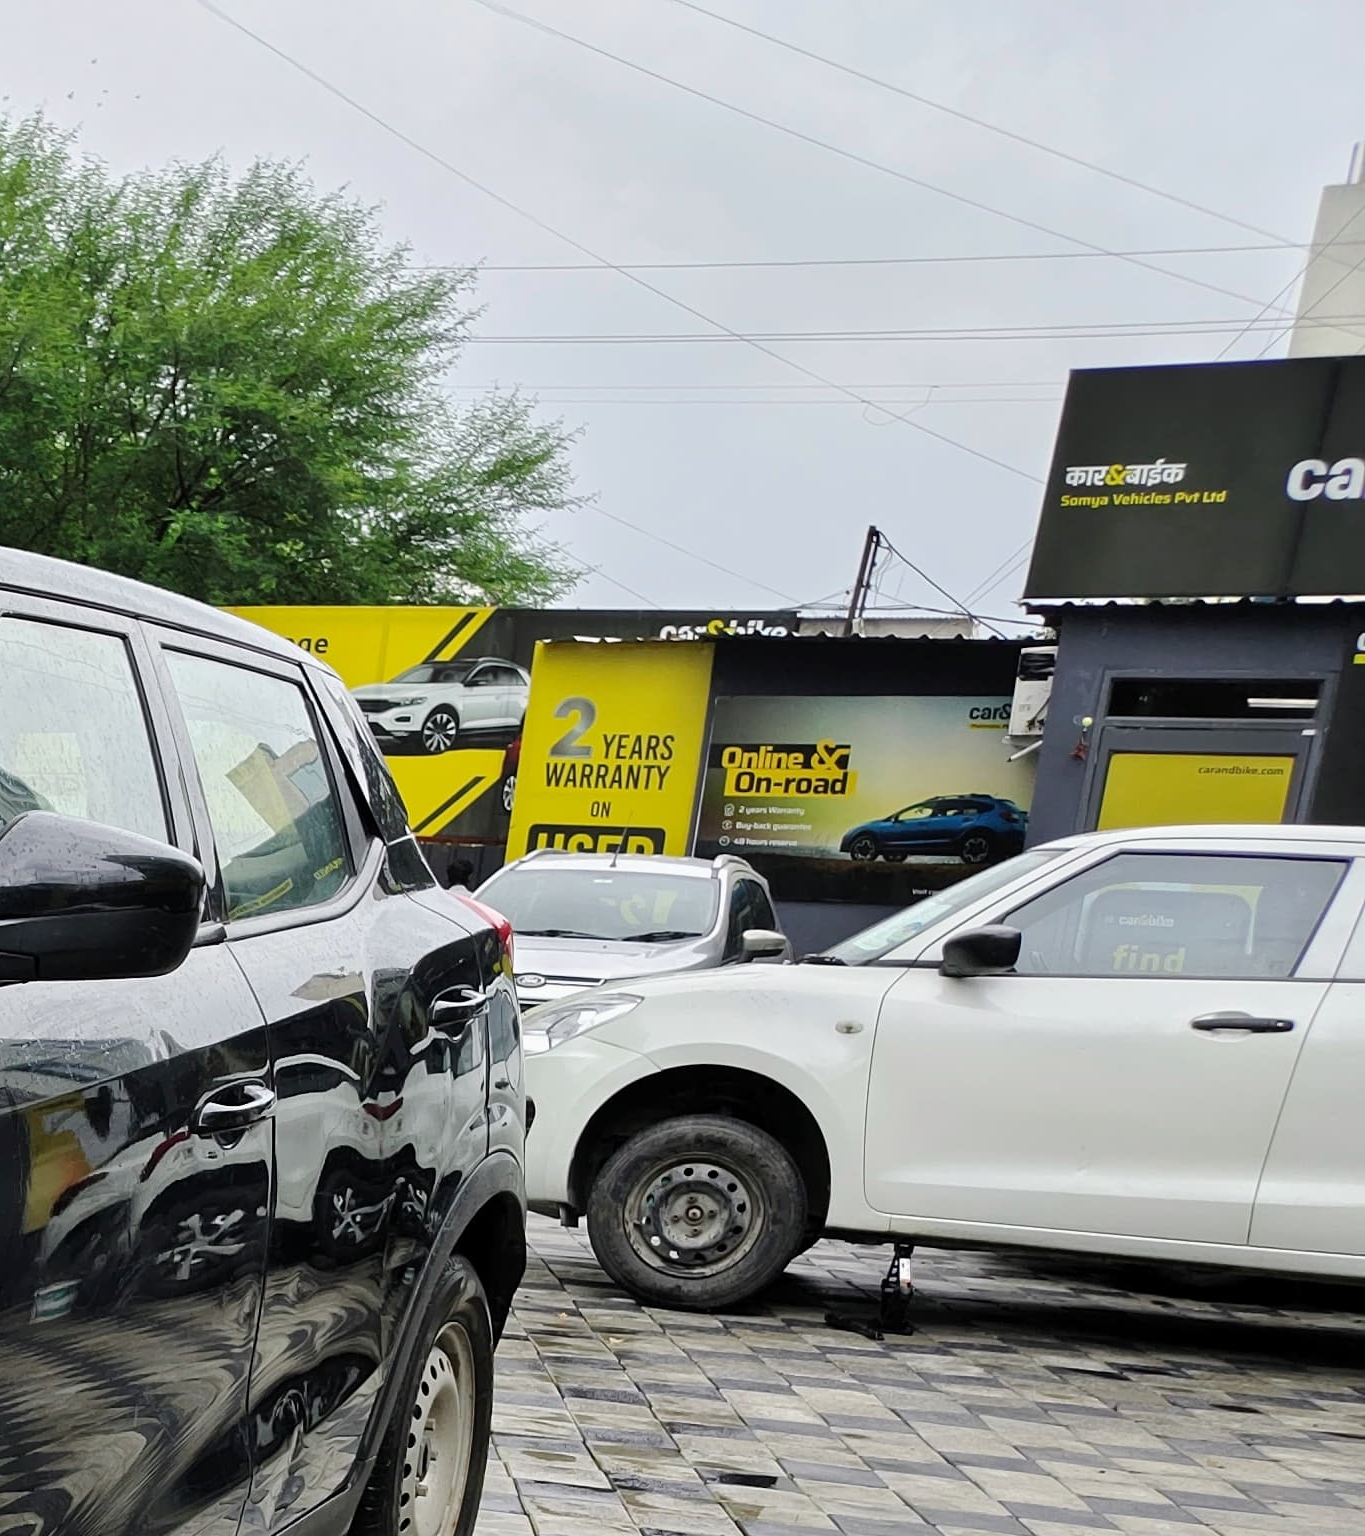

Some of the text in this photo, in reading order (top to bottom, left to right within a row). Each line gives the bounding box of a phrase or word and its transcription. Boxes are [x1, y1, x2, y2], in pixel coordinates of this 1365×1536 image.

[1112, 493, 1171, 506] Vehicles
[1174, 491, 1200, 504] Pvt
[1202, 490, 1228, 504] Ltd
[548, 696, 675, 761] 2 YEARS
[721, 738, 851, 771] Online &
[545, 762, 671, 791] WARRANTY
[734, 770, 849, 795] On-road
[1197, 765, 1285, 776] carandbike.com
[590, 801, 611, 818] ON
[1112, 943, 1186, 973] find
